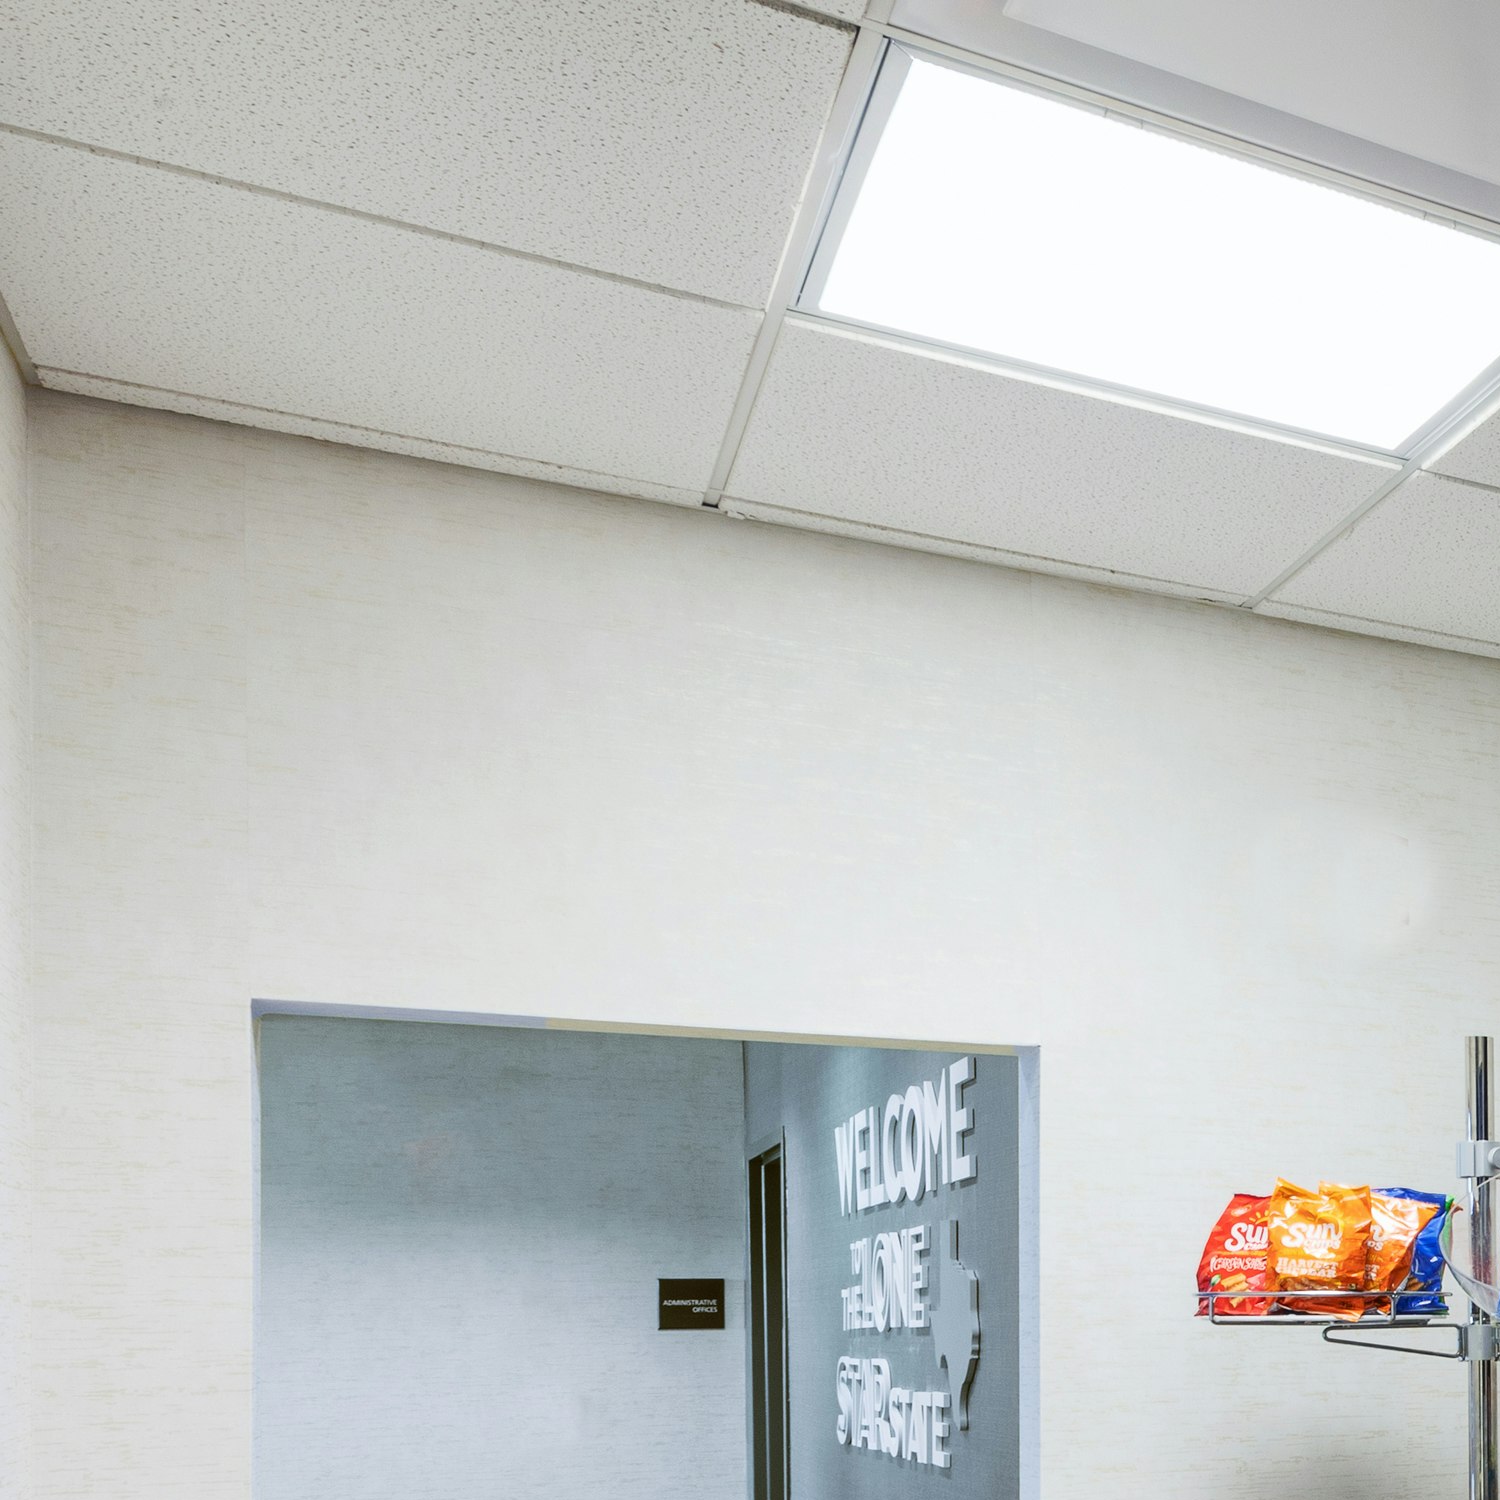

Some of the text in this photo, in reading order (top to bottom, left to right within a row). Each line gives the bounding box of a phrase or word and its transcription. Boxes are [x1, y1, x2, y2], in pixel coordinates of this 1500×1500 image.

[835, 1057, 977, 1216] WELCOME
[841, 1225, 931, 1332] TO THE LONE
[1277, 1257, 1339, 1268] HARVEST
[837, 1356, 950, 1468] STAR STATE
